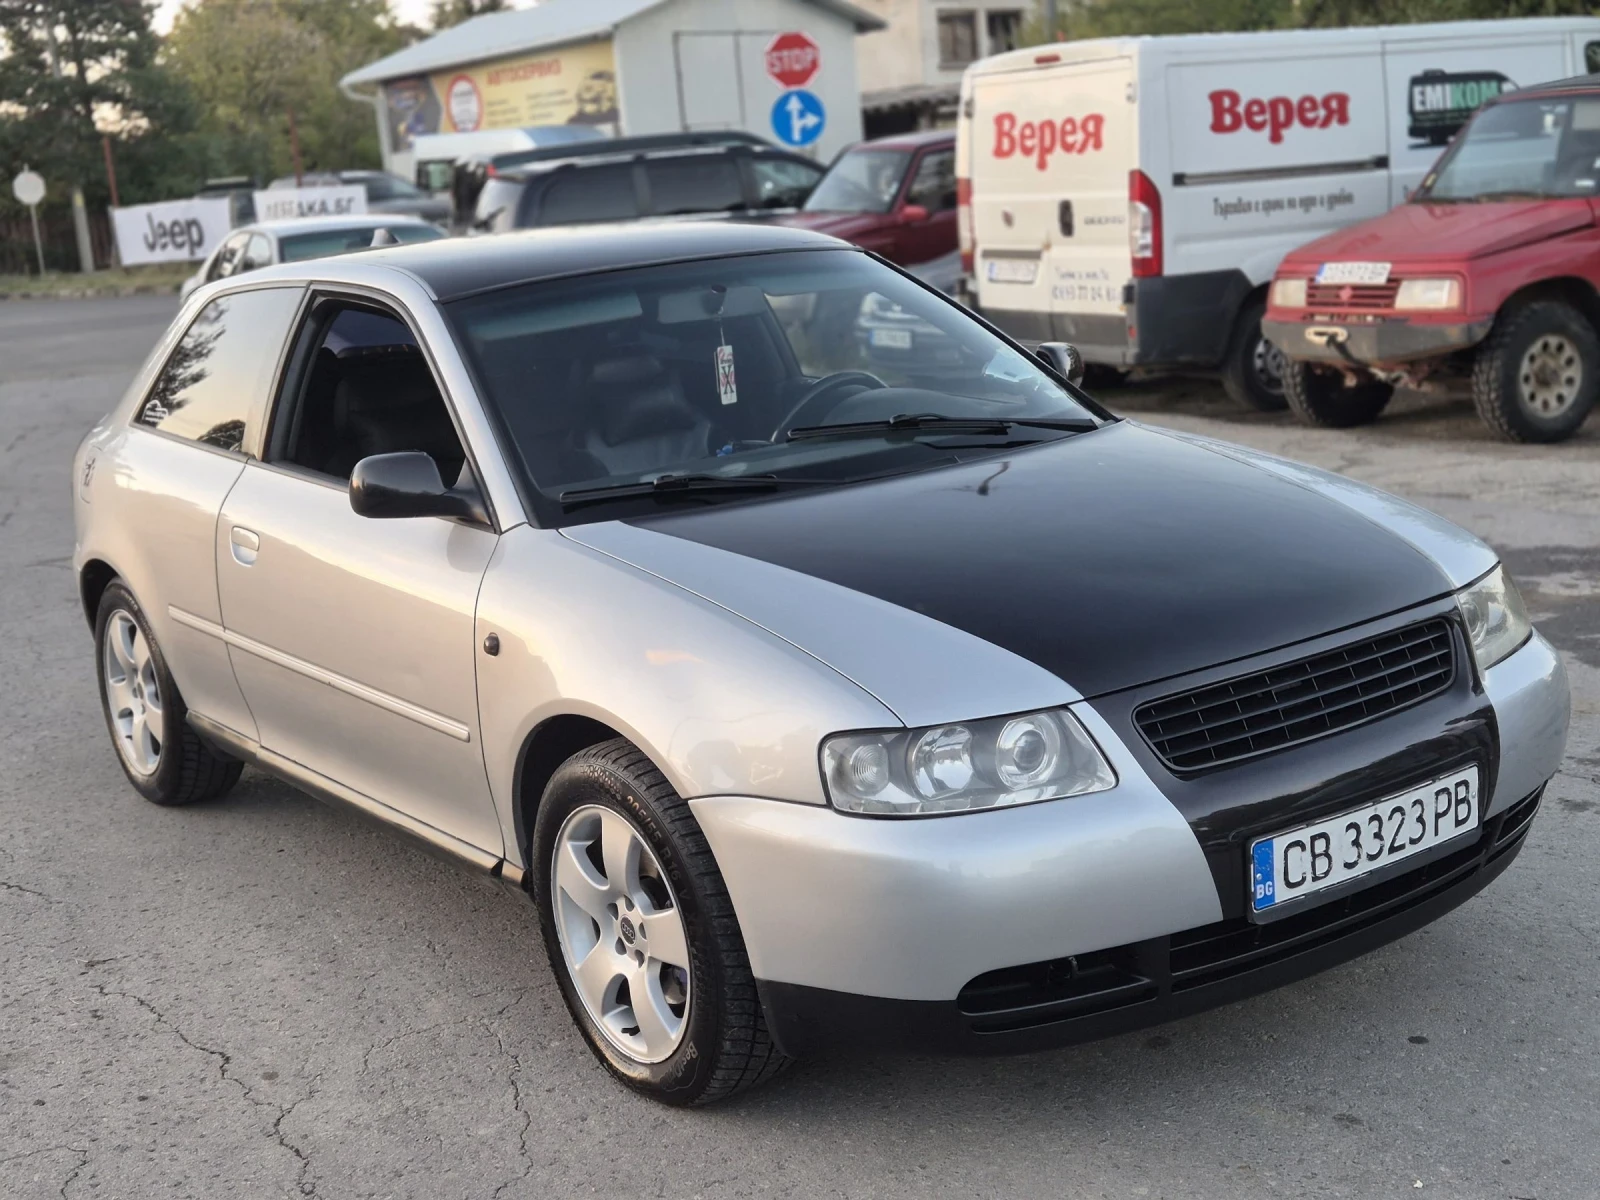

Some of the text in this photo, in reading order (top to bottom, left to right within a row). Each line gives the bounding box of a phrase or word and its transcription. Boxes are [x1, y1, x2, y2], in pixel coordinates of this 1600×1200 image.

[766, 47, 818, 73] STOP
[1208, 89, 1350, 145] Верея
[1412, 80, 1499, 111] EMIKOM
[992, 112, 1105, 172] Верея
[144, 212, 204, 256] Jeep
[1282, 779, 1473, 889] CB 3323 PB
[1256, 881, 1274, 899] BG
